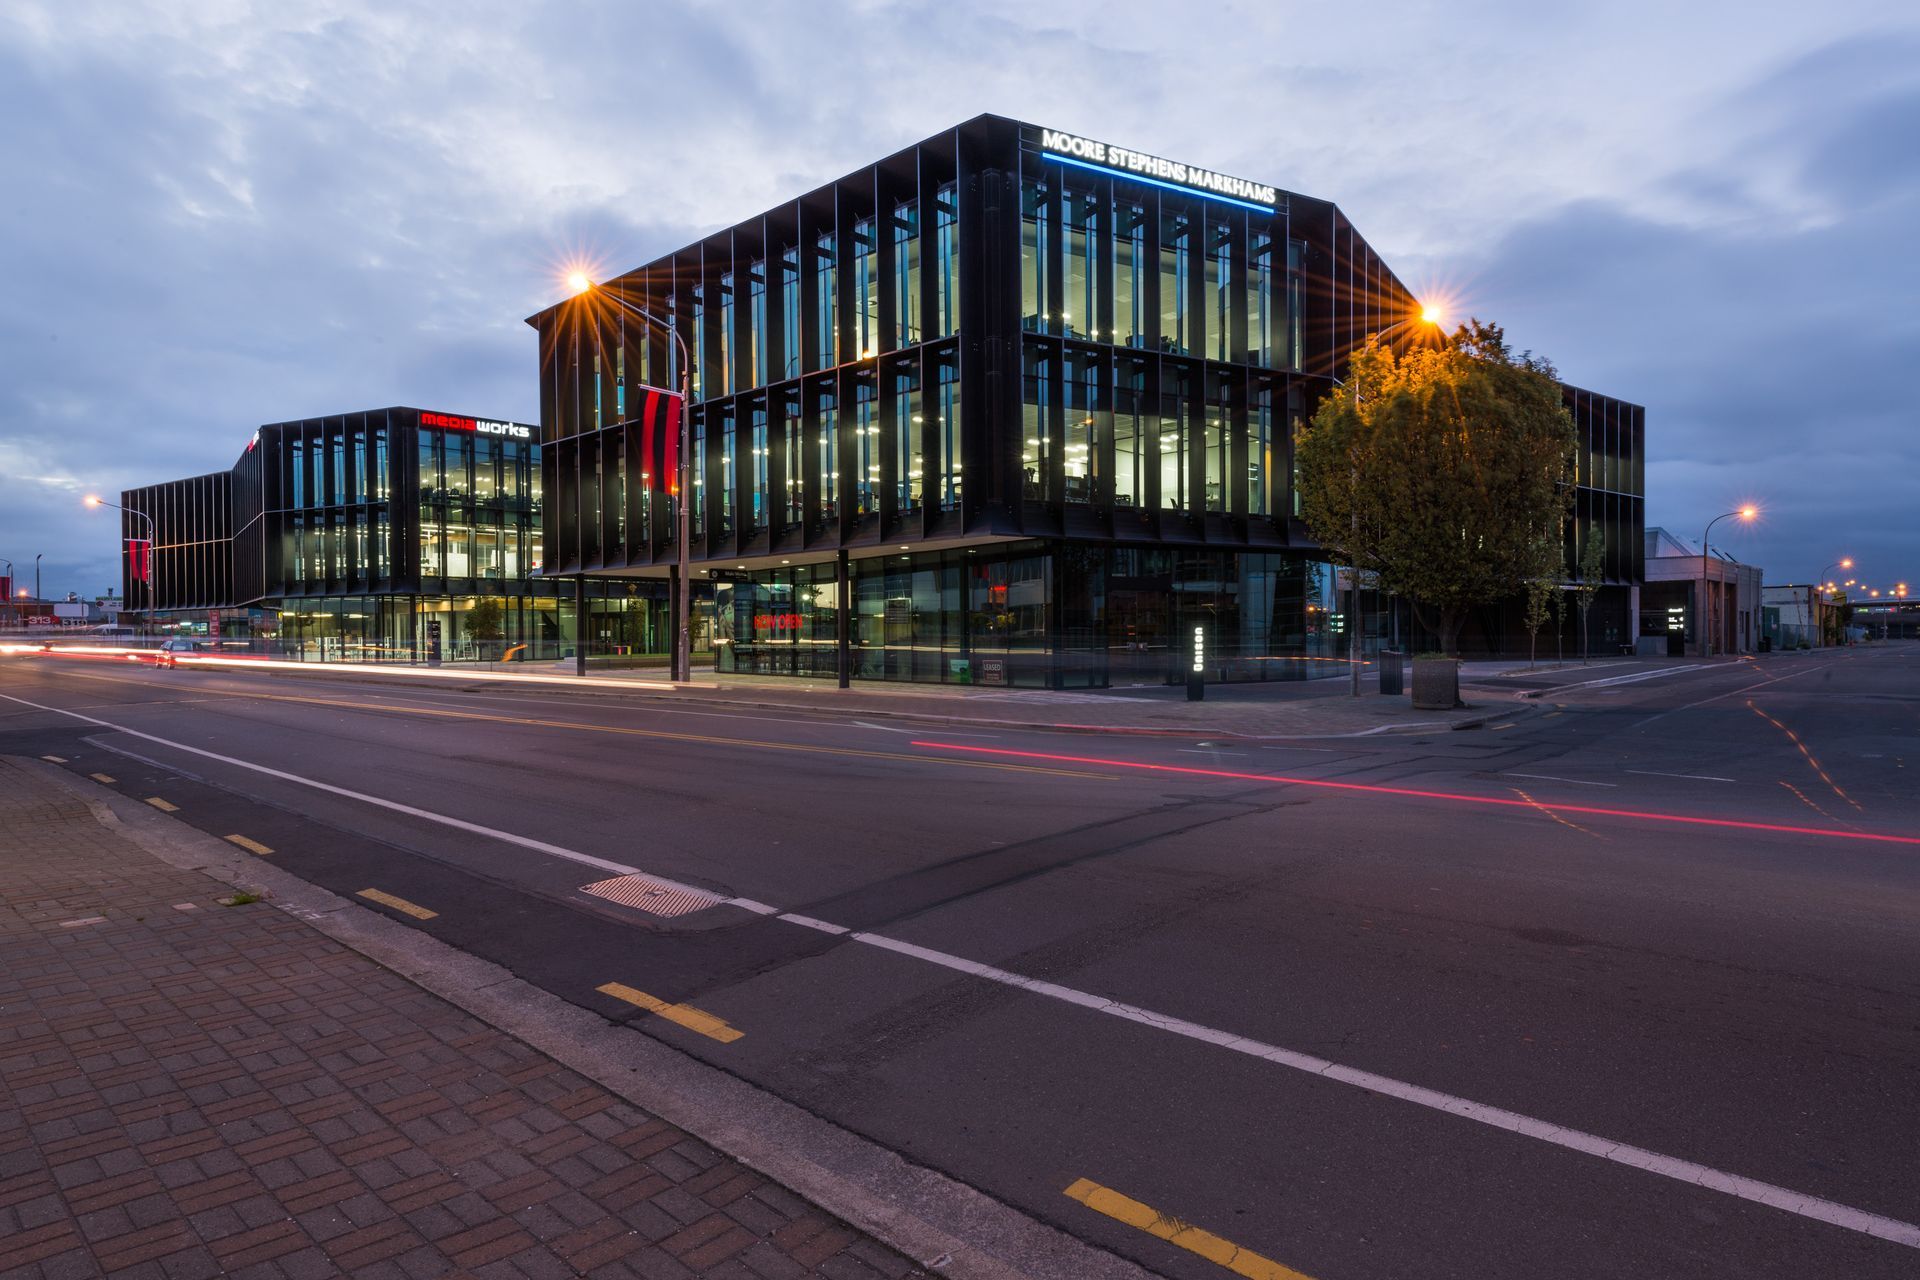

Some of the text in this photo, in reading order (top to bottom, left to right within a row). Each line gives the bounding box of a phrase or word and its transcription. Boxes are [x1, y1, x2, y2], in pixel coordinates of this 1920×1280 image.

[1042, 129, 1276, 204] MOORE STEPHENS MARKHAMS
[28, 616, 51, 624] 313
[754, 613, 803, 629] NOW OPEN
